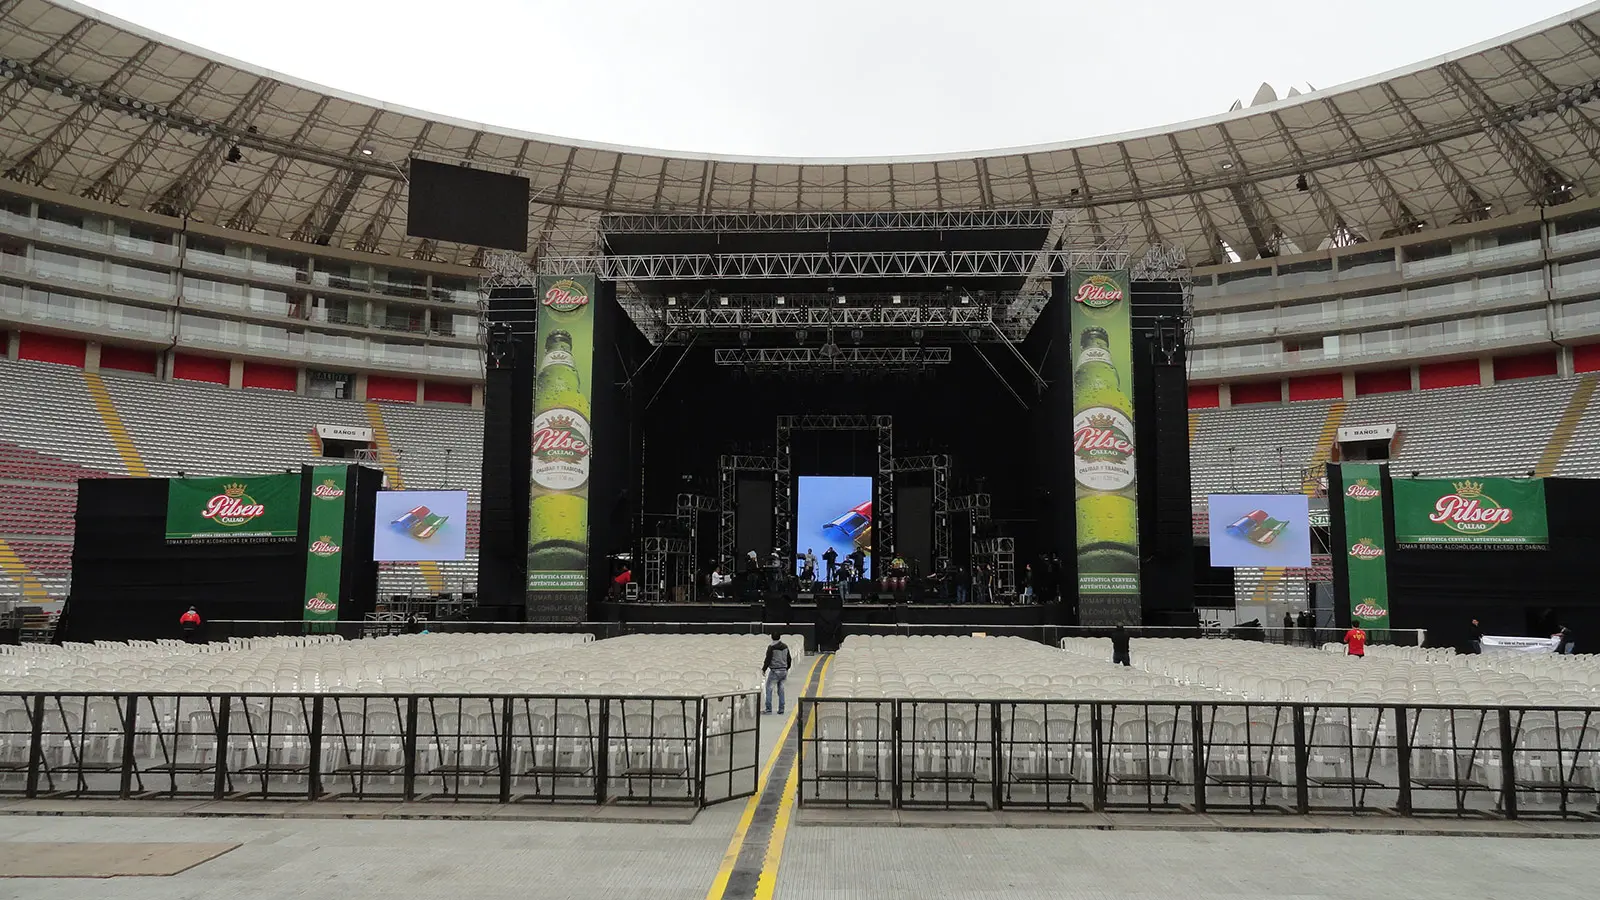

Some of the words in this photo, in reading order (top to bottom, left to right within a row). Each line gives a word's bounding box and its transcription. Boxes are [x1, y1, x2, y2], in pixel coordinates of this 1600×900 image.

[541, 288, 589, 306] Pilsen
[1074, 284, 1123, 302] Pilsen
[313, 485, 344, 496] Pilsen
[1345, 485, 1380, 497] Pilsen
[202, 494, 264, 518] Pilsen
[1428, 494, 1512, 523] Pilsen
[1457, 522, 1486, 530] CALLAO
[309, 541, 340, 553] Pilsen
[1349, 543, 1384, 556] Pilsen
[305, 598, 336, 610] Pilsen
[1353, 604, 1387, 616] Pilsen
